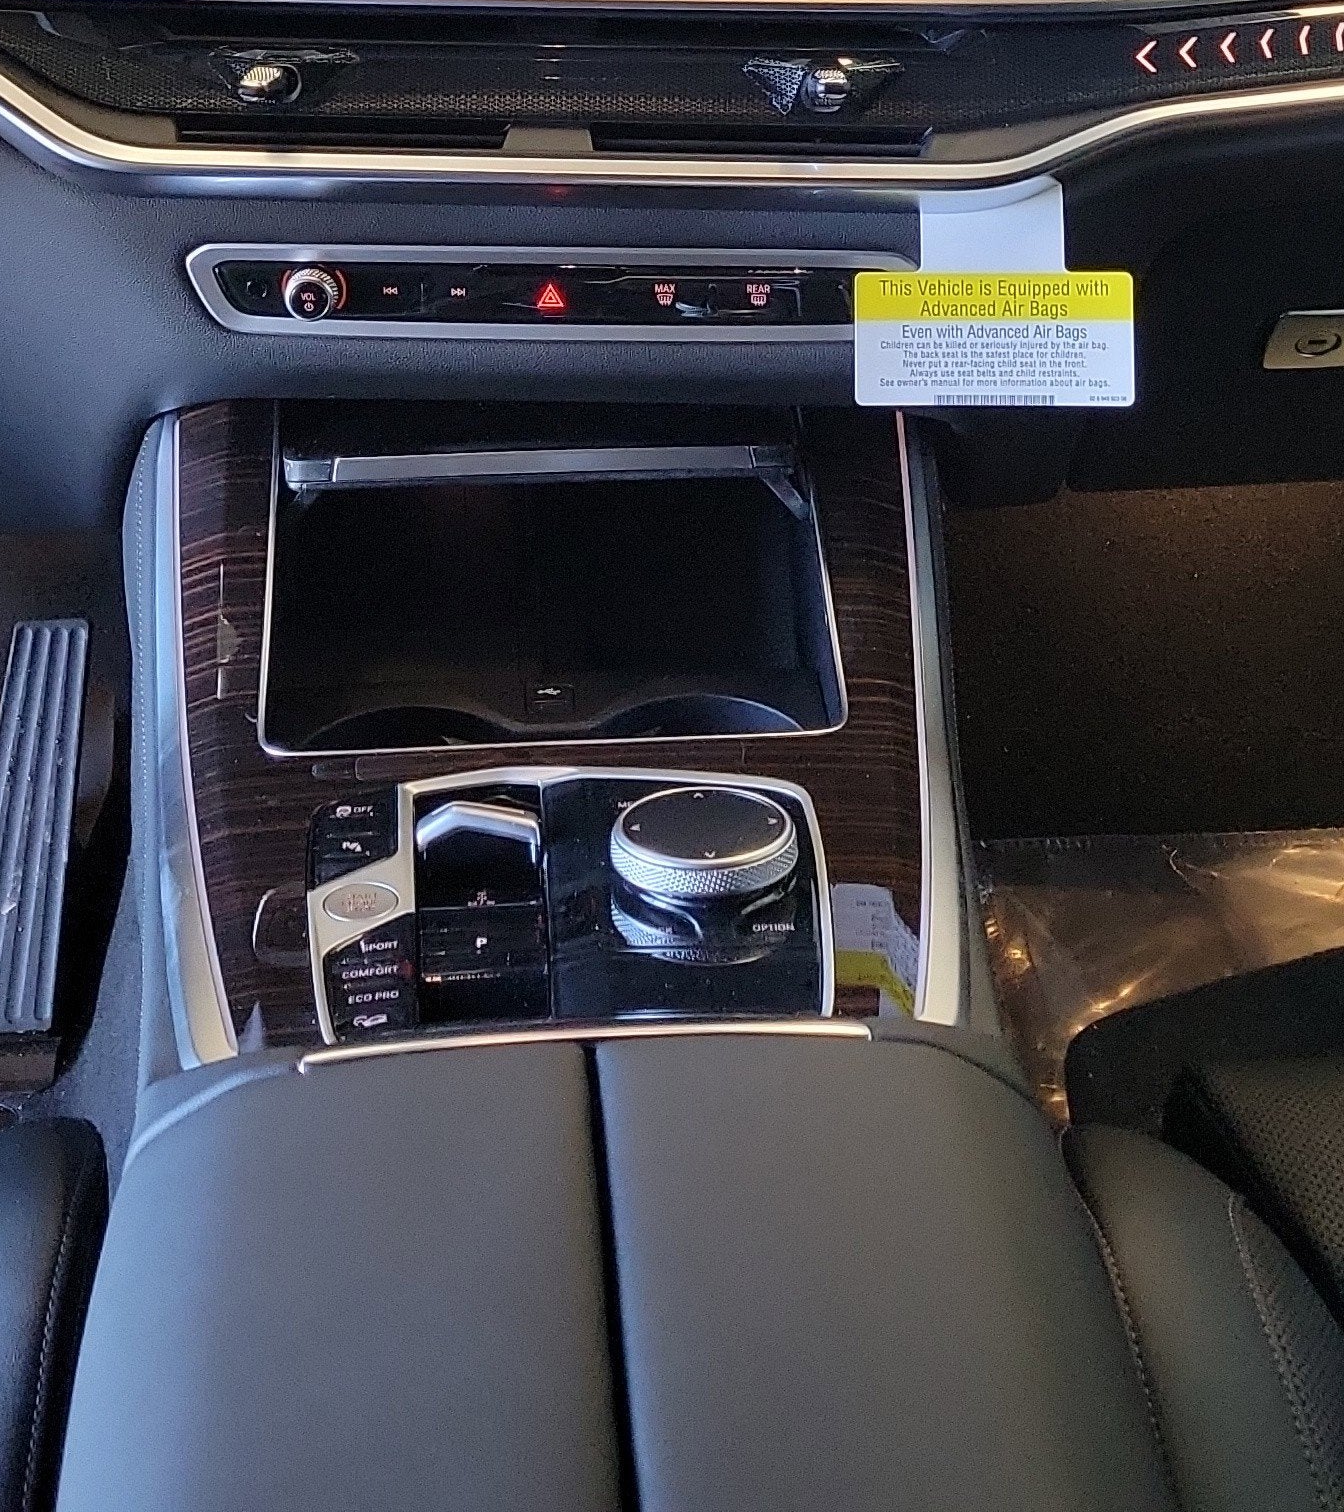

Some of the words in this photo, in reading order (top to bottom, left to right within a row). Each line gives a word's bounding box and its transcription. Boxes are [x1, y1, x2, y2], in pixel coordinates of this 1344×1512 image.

[654, 283, 676, 294] MAX
[746, 284, 771, 294] REAR
[879, 279, 912, 296] This
[918, 279, 973, 296] Vehicle
[979, 279, 992, 296] is
[997, 279, 1070, 299] Equipped
[1076, 279, 1109, 296] with
[300, 292, 316, 301] VOL
[920, 300, 996, 317] Advanced
[1002, 300, 1024, 317] Air
[1030, 300, 1068, 320] Bags
[902, 324, 932, 339] Even
[936, 324, 963, 339] with
[967, 324, 1029, 339] Advanced
[1033, 324, 1051, 339] Air
[1055, 324, 1088, 341] Bags
[880, 341, 914, 349] Children
[916, 341, 931, 349] can
[933, 341, 943, 349] be
[945, 341, 967, 349] killed
[969, 341, 978, 349] or
[981, 341, 1017, 350] seriously
[1020, 341, 1048, 350] injured
[1051, 341, 1061, 350] by
[1063, 341, 1076, 349] the
[1078, 341, 1089, 349] air
[1091, 341, 1109, 350] bag.
[903, 350, 918, 358] The
[920, 350, 938, 358] back
[941, 350, 959, 358] seat
[961, 350, 968, 358] is
[970, 350, 983, 358] the
[985, 350, 1010, 358] safest
[1012, 350, 1034, 359] place
[1036, 350, 1048, 358] for
[1050, 350, 1086, 358] children.
[902, 360, 926, 368] Never
[928, 360, 942, 369] put
[951, 360, 995, 369] rear-facing
[997, 360, 1017, 368] child
[1019, 360, 1036, 368] seat
[1039, 360, 1047, 368] in
[1049, 360, 1062, 368] the
[1064, 360, 1087, 368] front.
[910, 369, 938, 378] Always
[957, 369, 974, 377] seat
[976, 369, 996, 377] belts
[998, 369, 1013, 377] and
[1016, 369, 1036, 377] child
[1038, 369, 1080, 377] restraints.
[879, 378, 894, 387] See
[896, 378, 928, 387] owner's
[930, 378, 960, 387] manual
[962, 378, 974, 387] for
[976, 378, 997, 387] more
[1000, 378, 1047, 387] information
[1049, 378, 1073, 387] about
[1075, 378, 1086, 387] air
[1088, 378, 1111, 388] bags.
[752, 923, 796, 932] OPTION
[476, 937, 487, 949] P
[341, 964, 399, 980] COMFORT
[374, 989, 399, 1003] PRO
